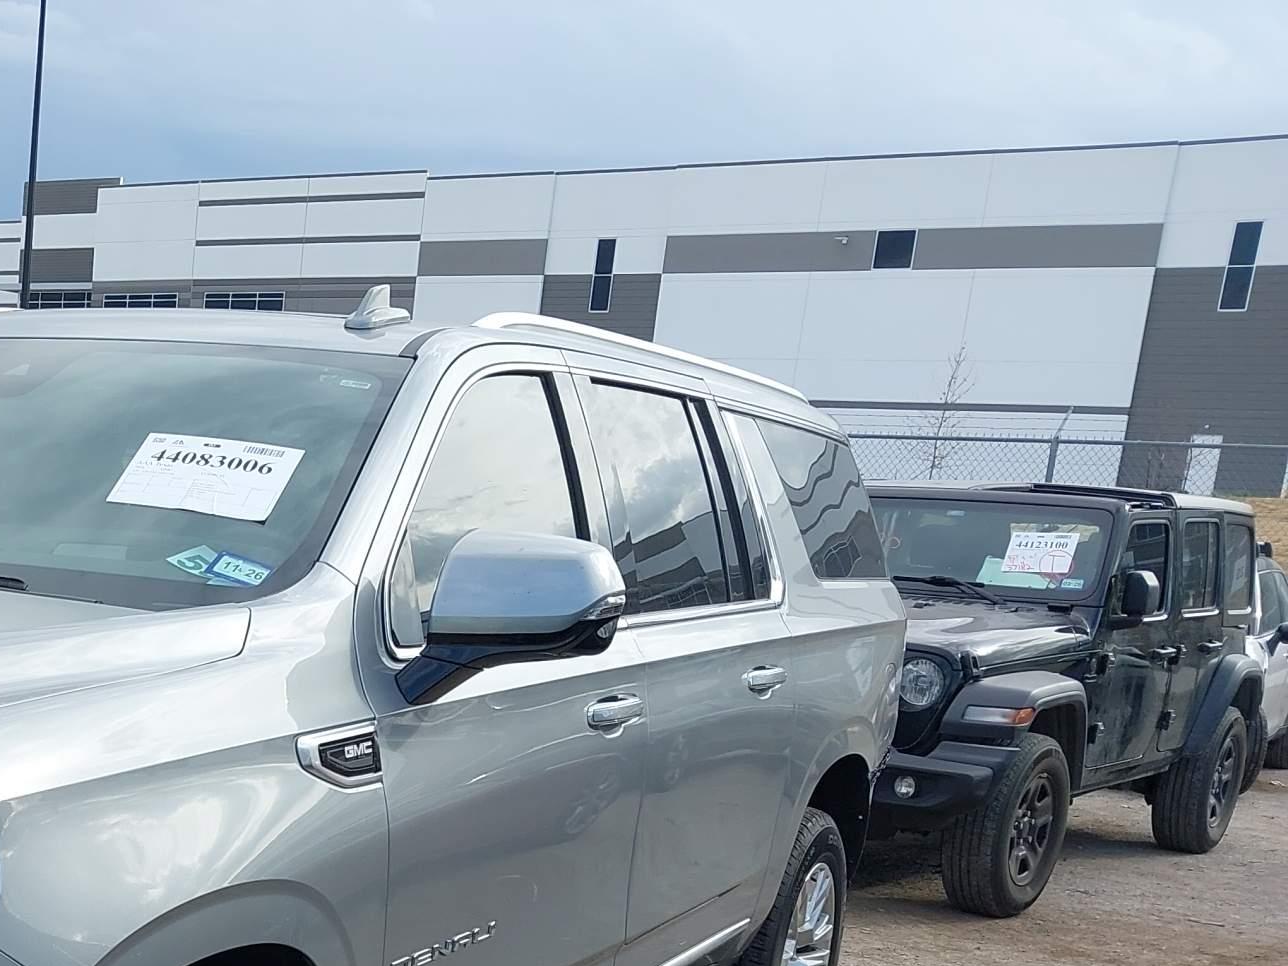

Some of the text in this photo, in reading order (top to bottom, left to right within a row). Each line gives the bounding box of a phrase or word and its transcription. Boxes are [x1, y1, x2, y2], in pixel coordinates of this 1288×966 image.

[150, 449, 277, 475] 44083006
[1015, 540, 1069, 549] 44123100
[244, 568, 265, 581] 26
[344, 741, 373, 758] GMC
